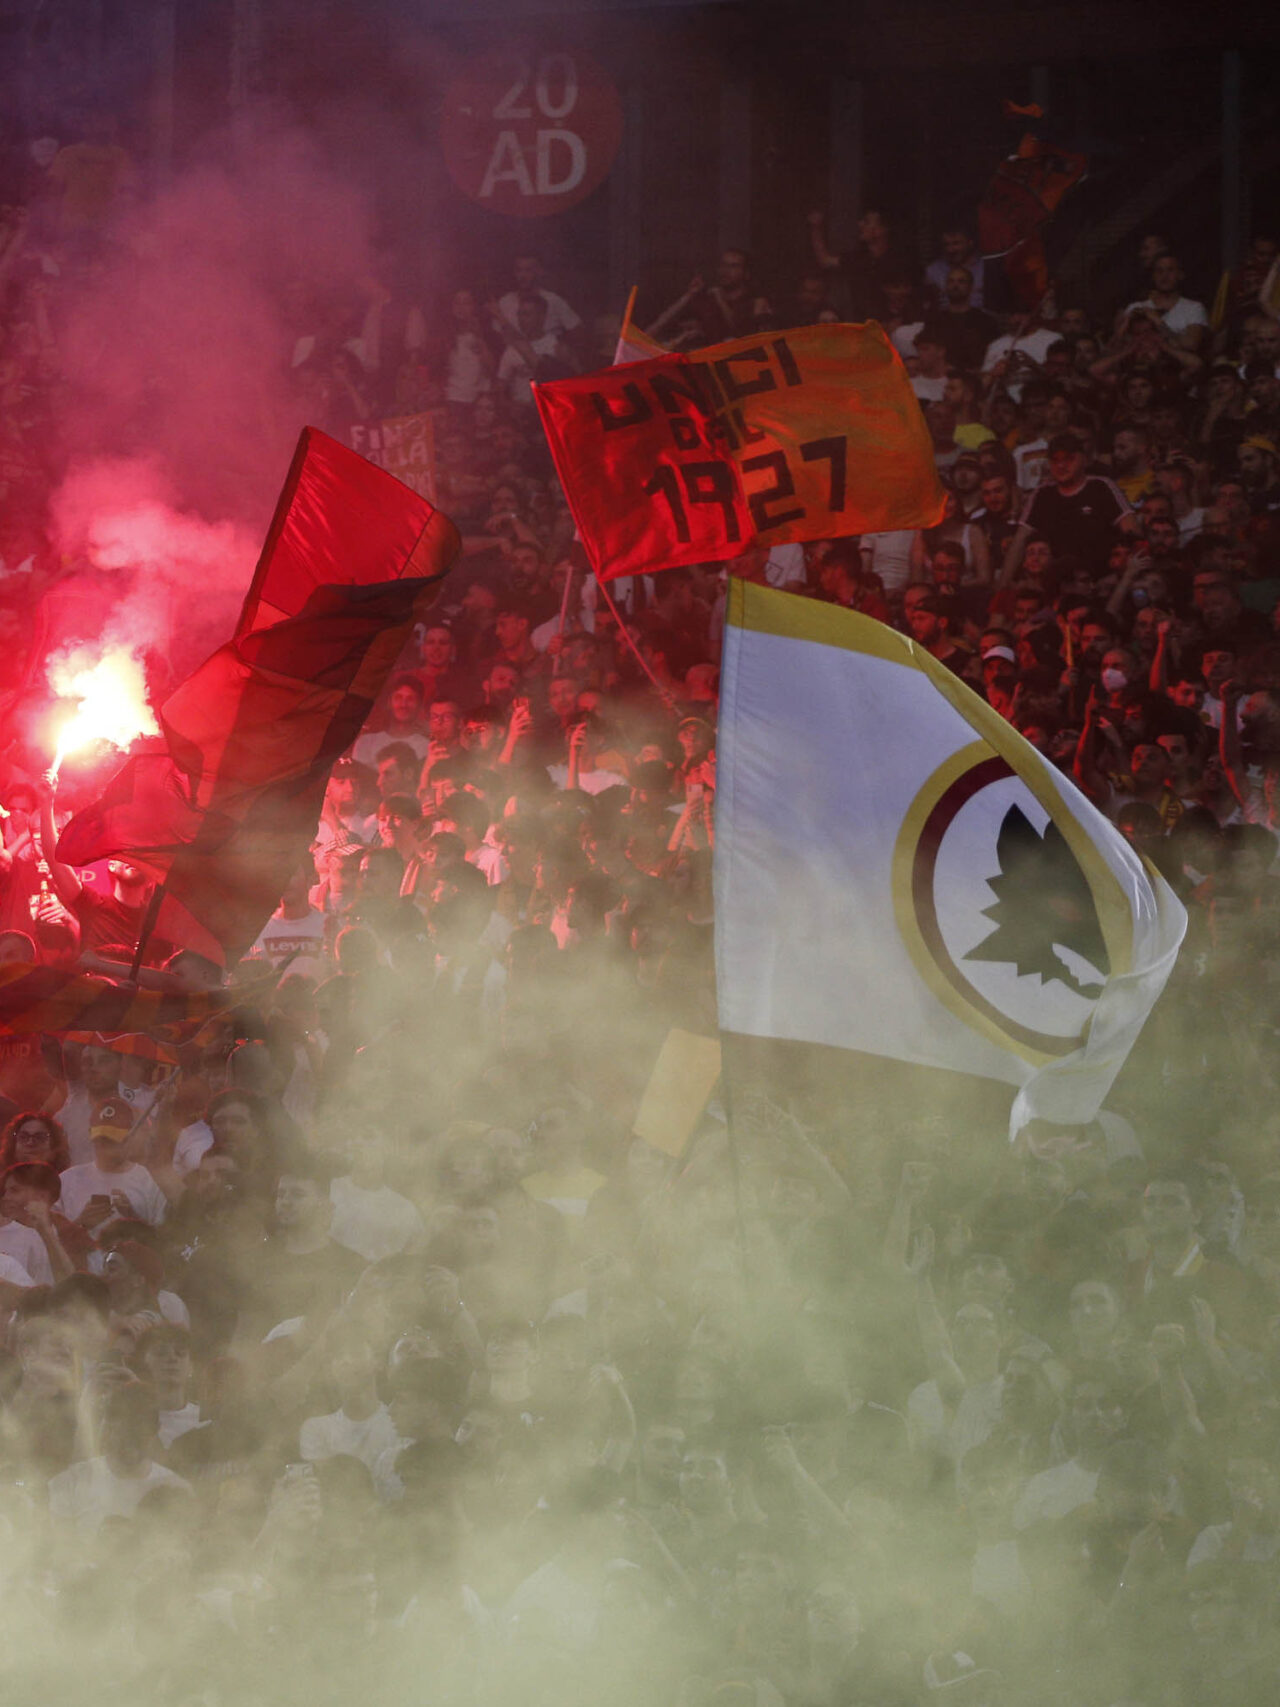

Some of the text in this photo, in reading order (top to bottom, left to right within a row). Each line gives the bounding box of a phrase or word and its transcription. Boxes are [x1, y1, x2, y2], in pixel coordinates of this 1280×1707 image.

[493, 54, 578, 118] 20
[479, 129, 587, 197] AD
[642, 435, 848, 544] 1927
